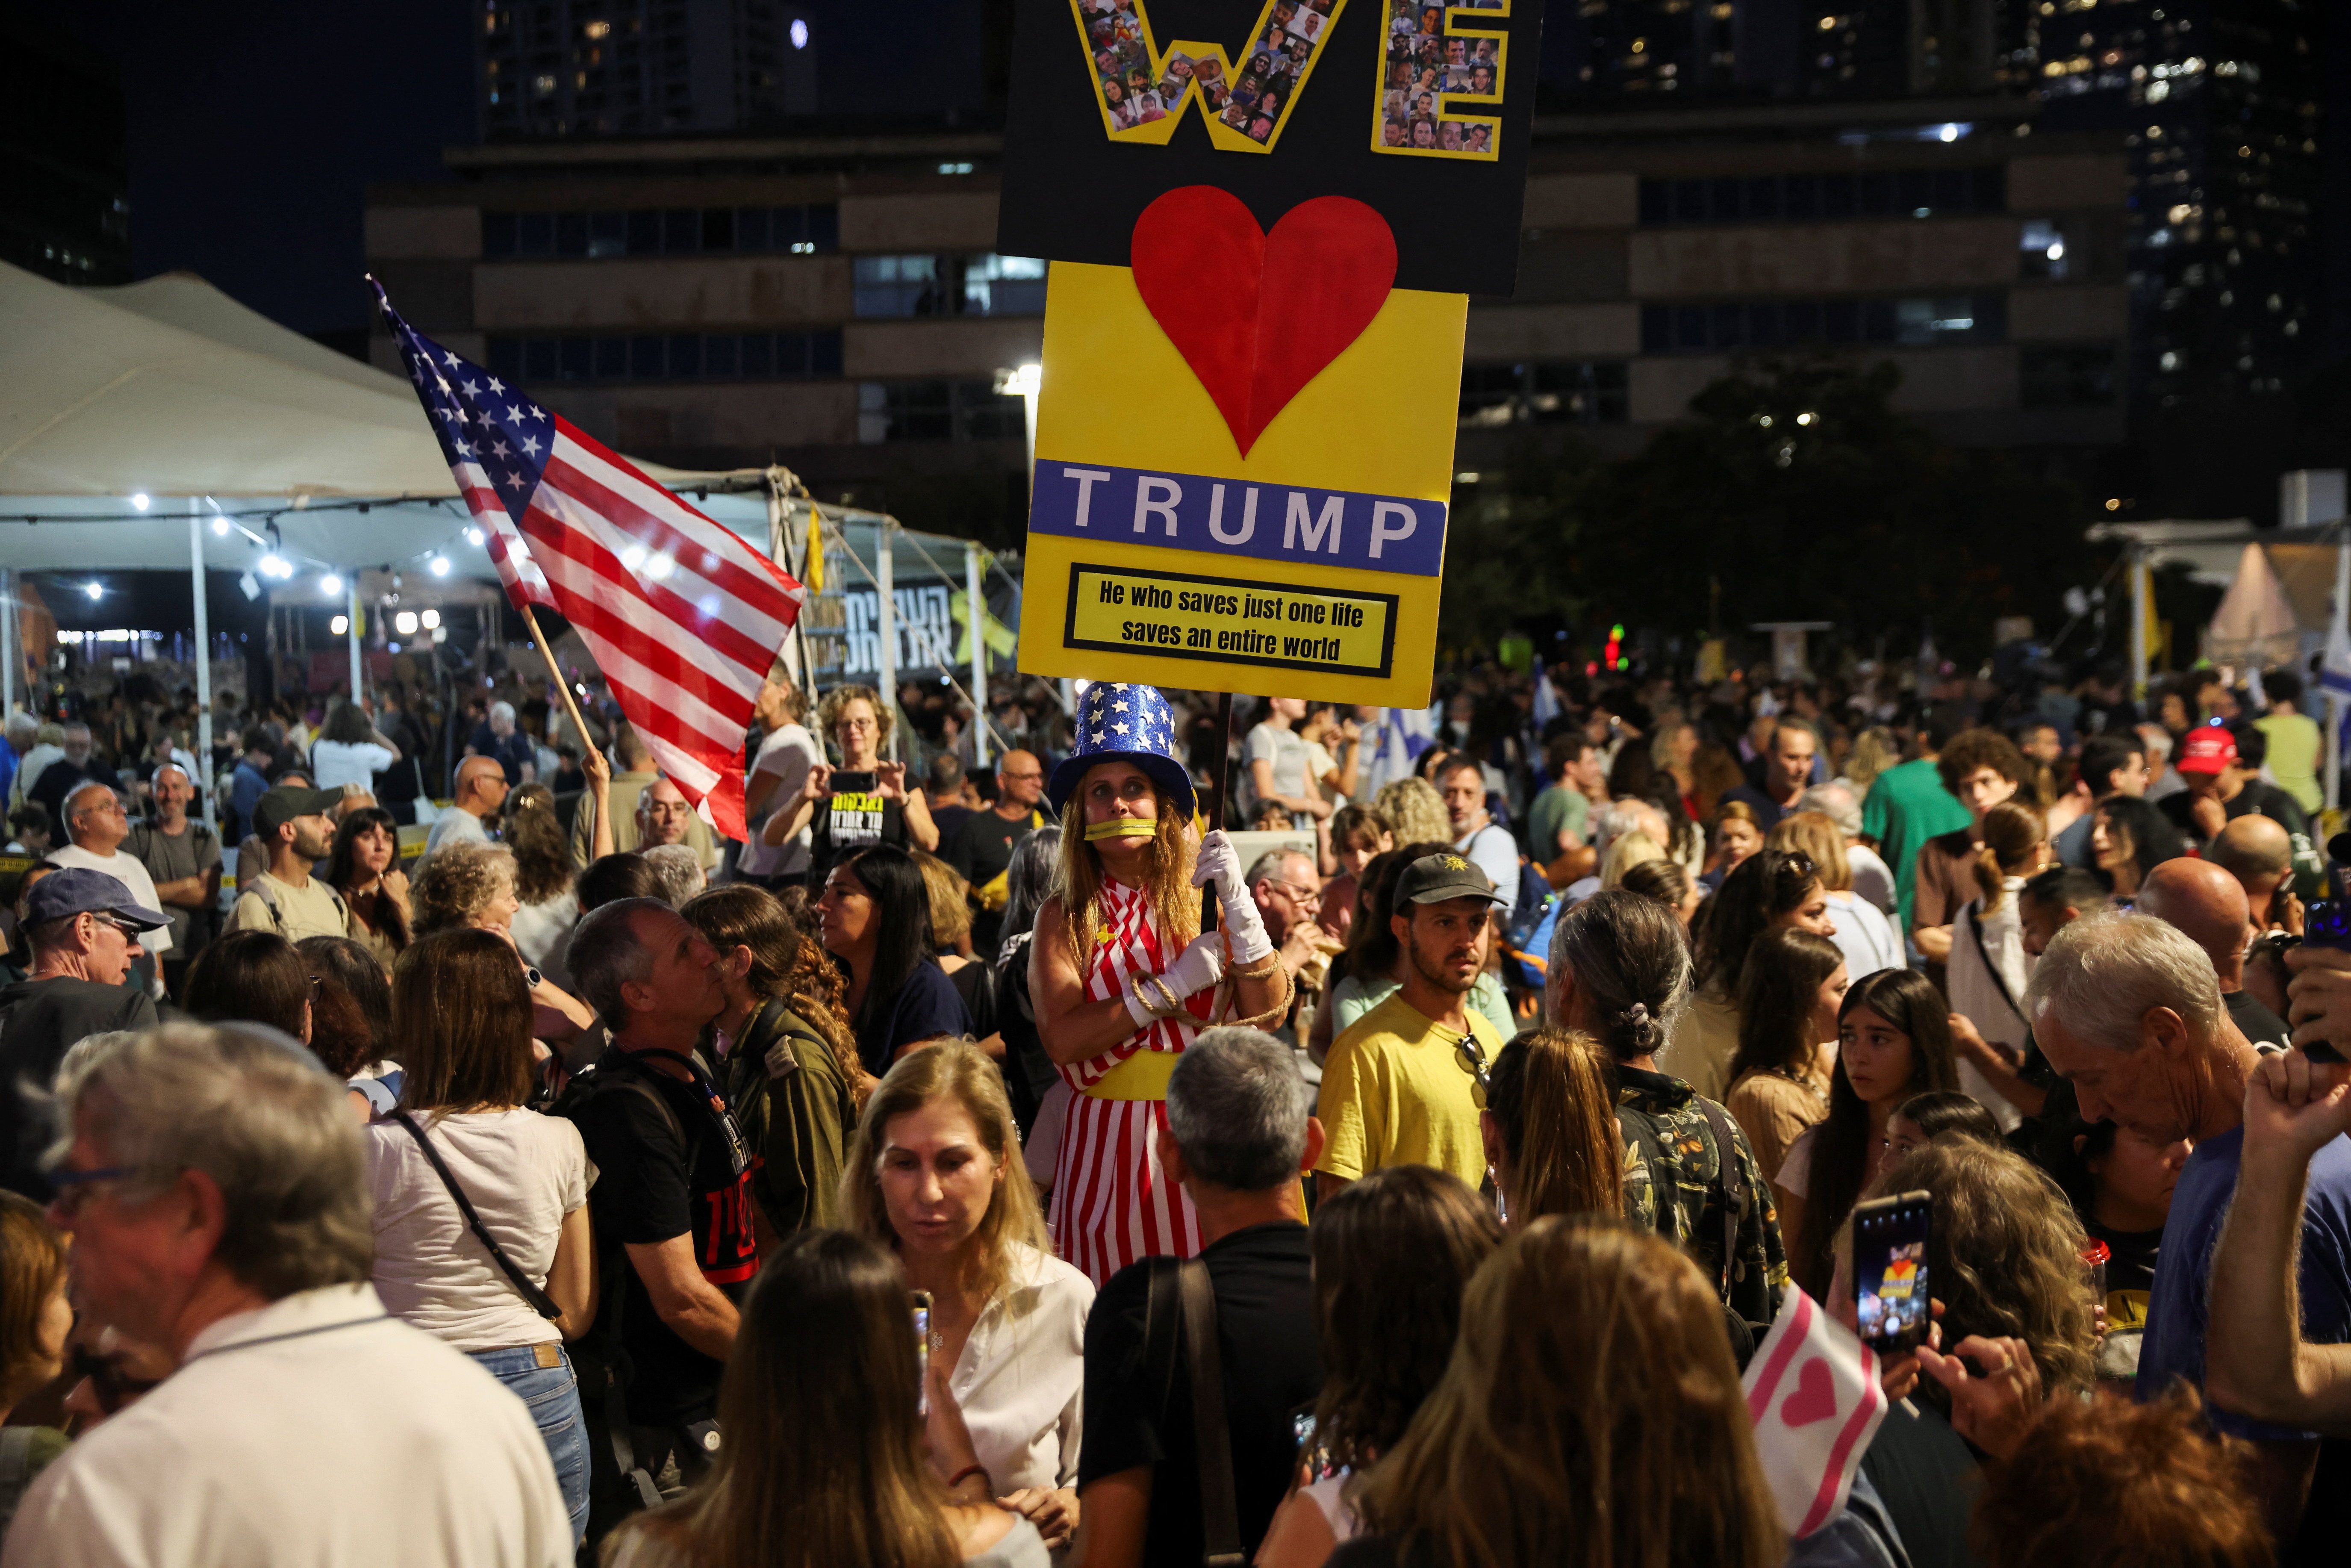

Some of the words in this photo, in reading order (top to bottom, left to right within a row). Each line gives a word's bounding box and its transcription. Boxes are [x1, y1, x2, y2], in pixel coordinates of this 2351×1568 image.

[1070, 0, 1511, 162] WE
[1063, 468, 1417, 559] TRUMP
[1100, 580, 1124, 604] He
[1131, 585, 1173, 609] who
[1178, 592, 1238, 616] saves
[1243, 593, 1283, 619] just
[1289, 602, 1326, 624] one
[1332, 602, 1364, 628] life
[1122, 621, 1181, 645] saves
[1187, 627, 1211, 648] an
[1217, 629, 1277, 654] entire
[1284, 637, 1340, 661] world
